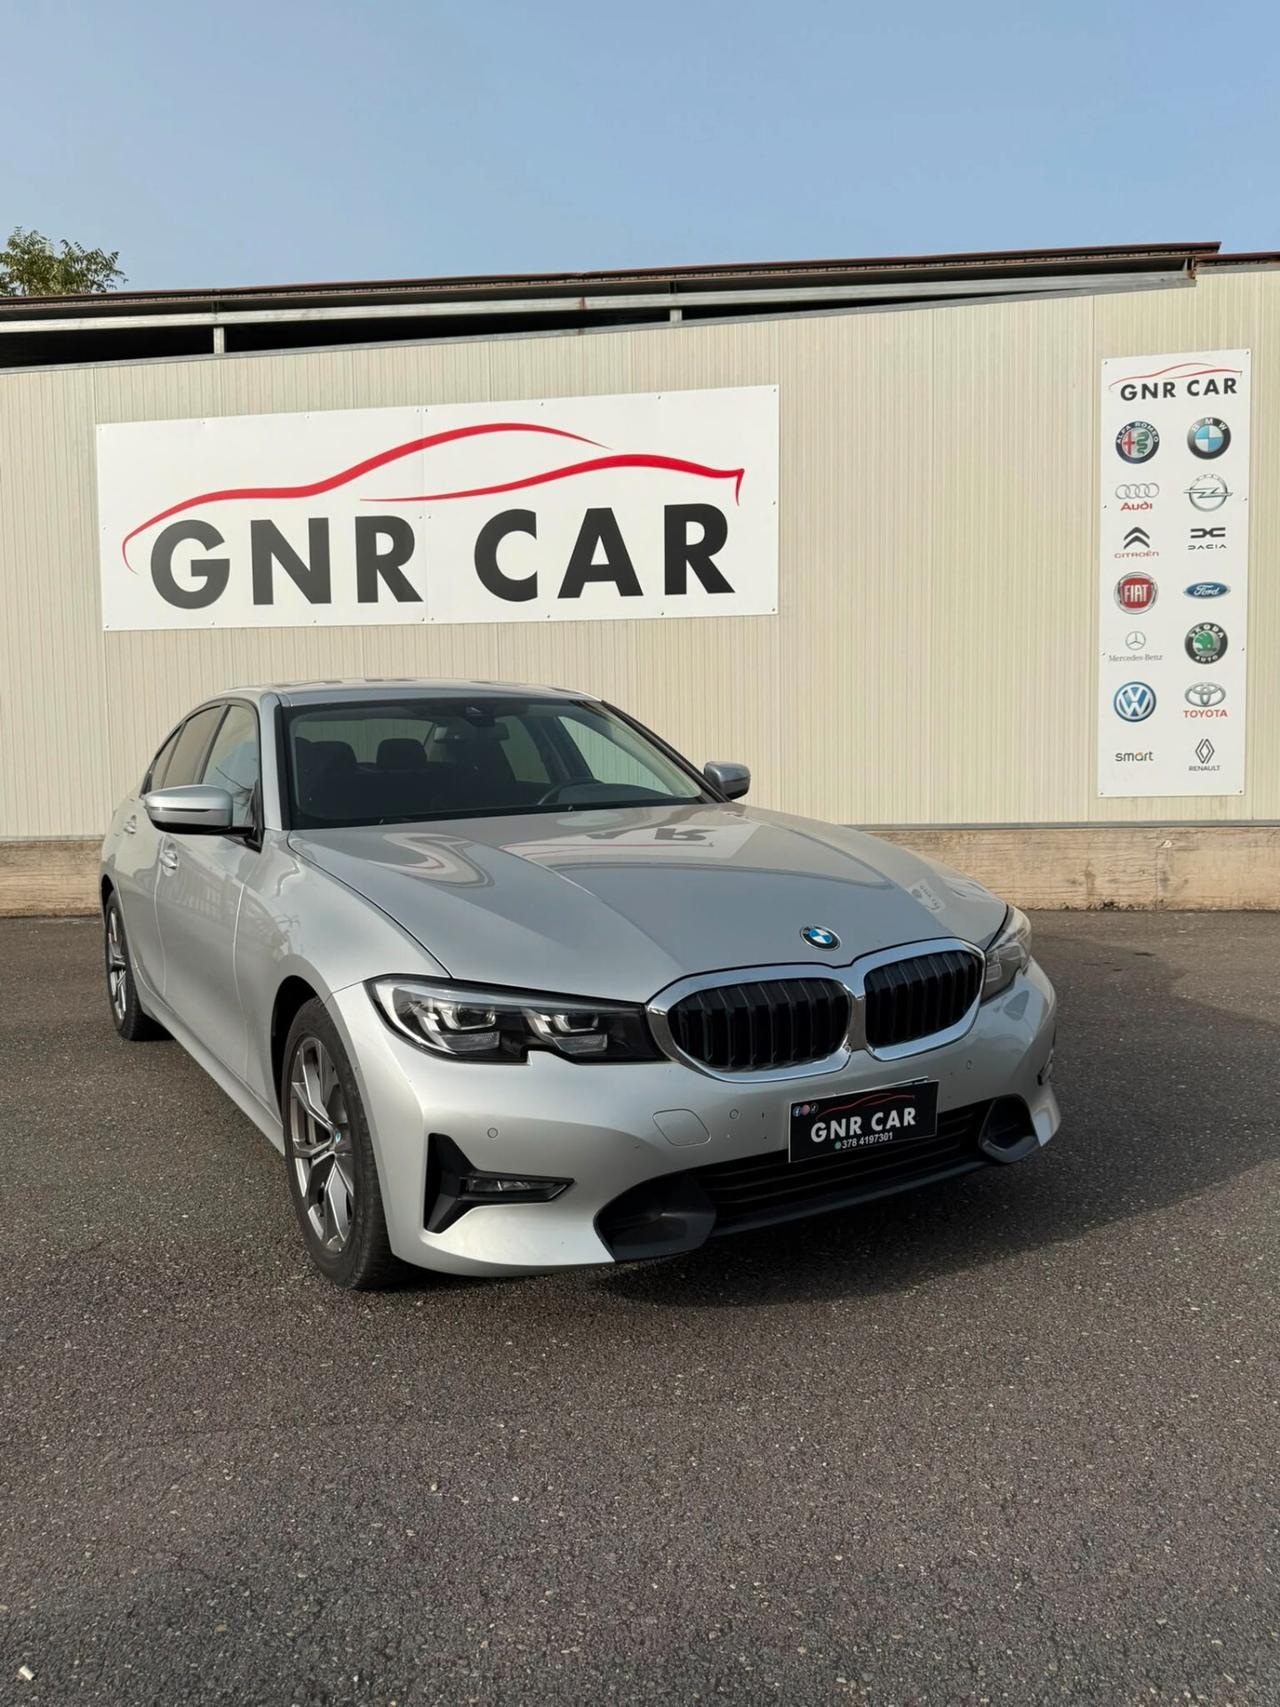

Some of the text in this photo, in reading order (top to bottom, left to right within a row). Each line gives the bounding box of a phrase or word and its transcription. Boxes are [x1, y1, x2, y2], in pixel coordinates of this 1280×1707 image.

[1120, 378, 1237, 401] GNR CAR
[1191, 418, 1228, 433] BMW
[1120, 501, 1153, 511] Audi
[150, 503, 736, 610] GNR CAR
[1124, 584, 1149, 602] FIAT
[1193, 584, 1220, 596] Ford
[1195, 654, 1218, 663] AUTO
[1184, 709, 1228, 718] TOYOTA
[1115, 751, 1154, 762] smart
[810, 1107, 916, 1143] GNR CAR
[841, 1131, 894, 1149] 378 4197301
